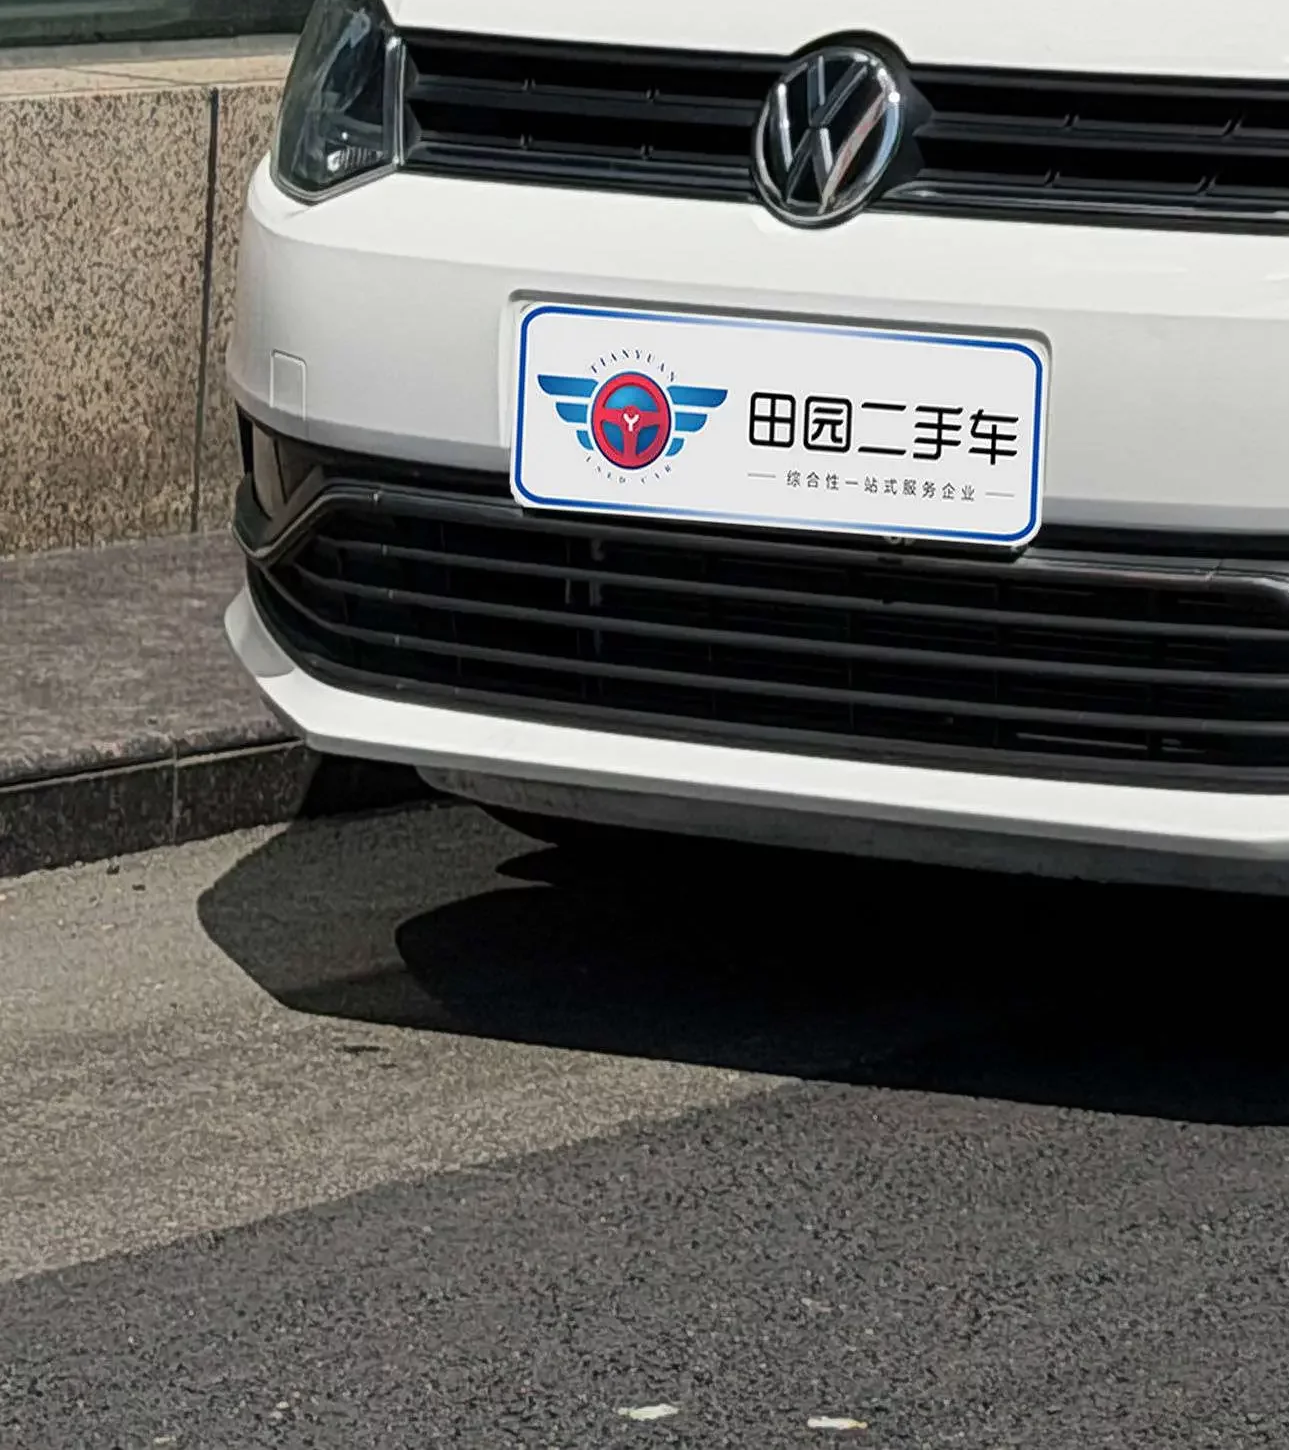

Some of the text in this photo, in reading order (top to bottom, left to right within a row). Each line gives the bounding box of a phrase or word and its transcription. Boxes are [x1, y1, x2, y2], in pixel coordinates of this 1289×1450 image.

[748, 391, 1020, 465] 田园二手车
[786, 469, 976, 502] 综合性一站式服务企业
